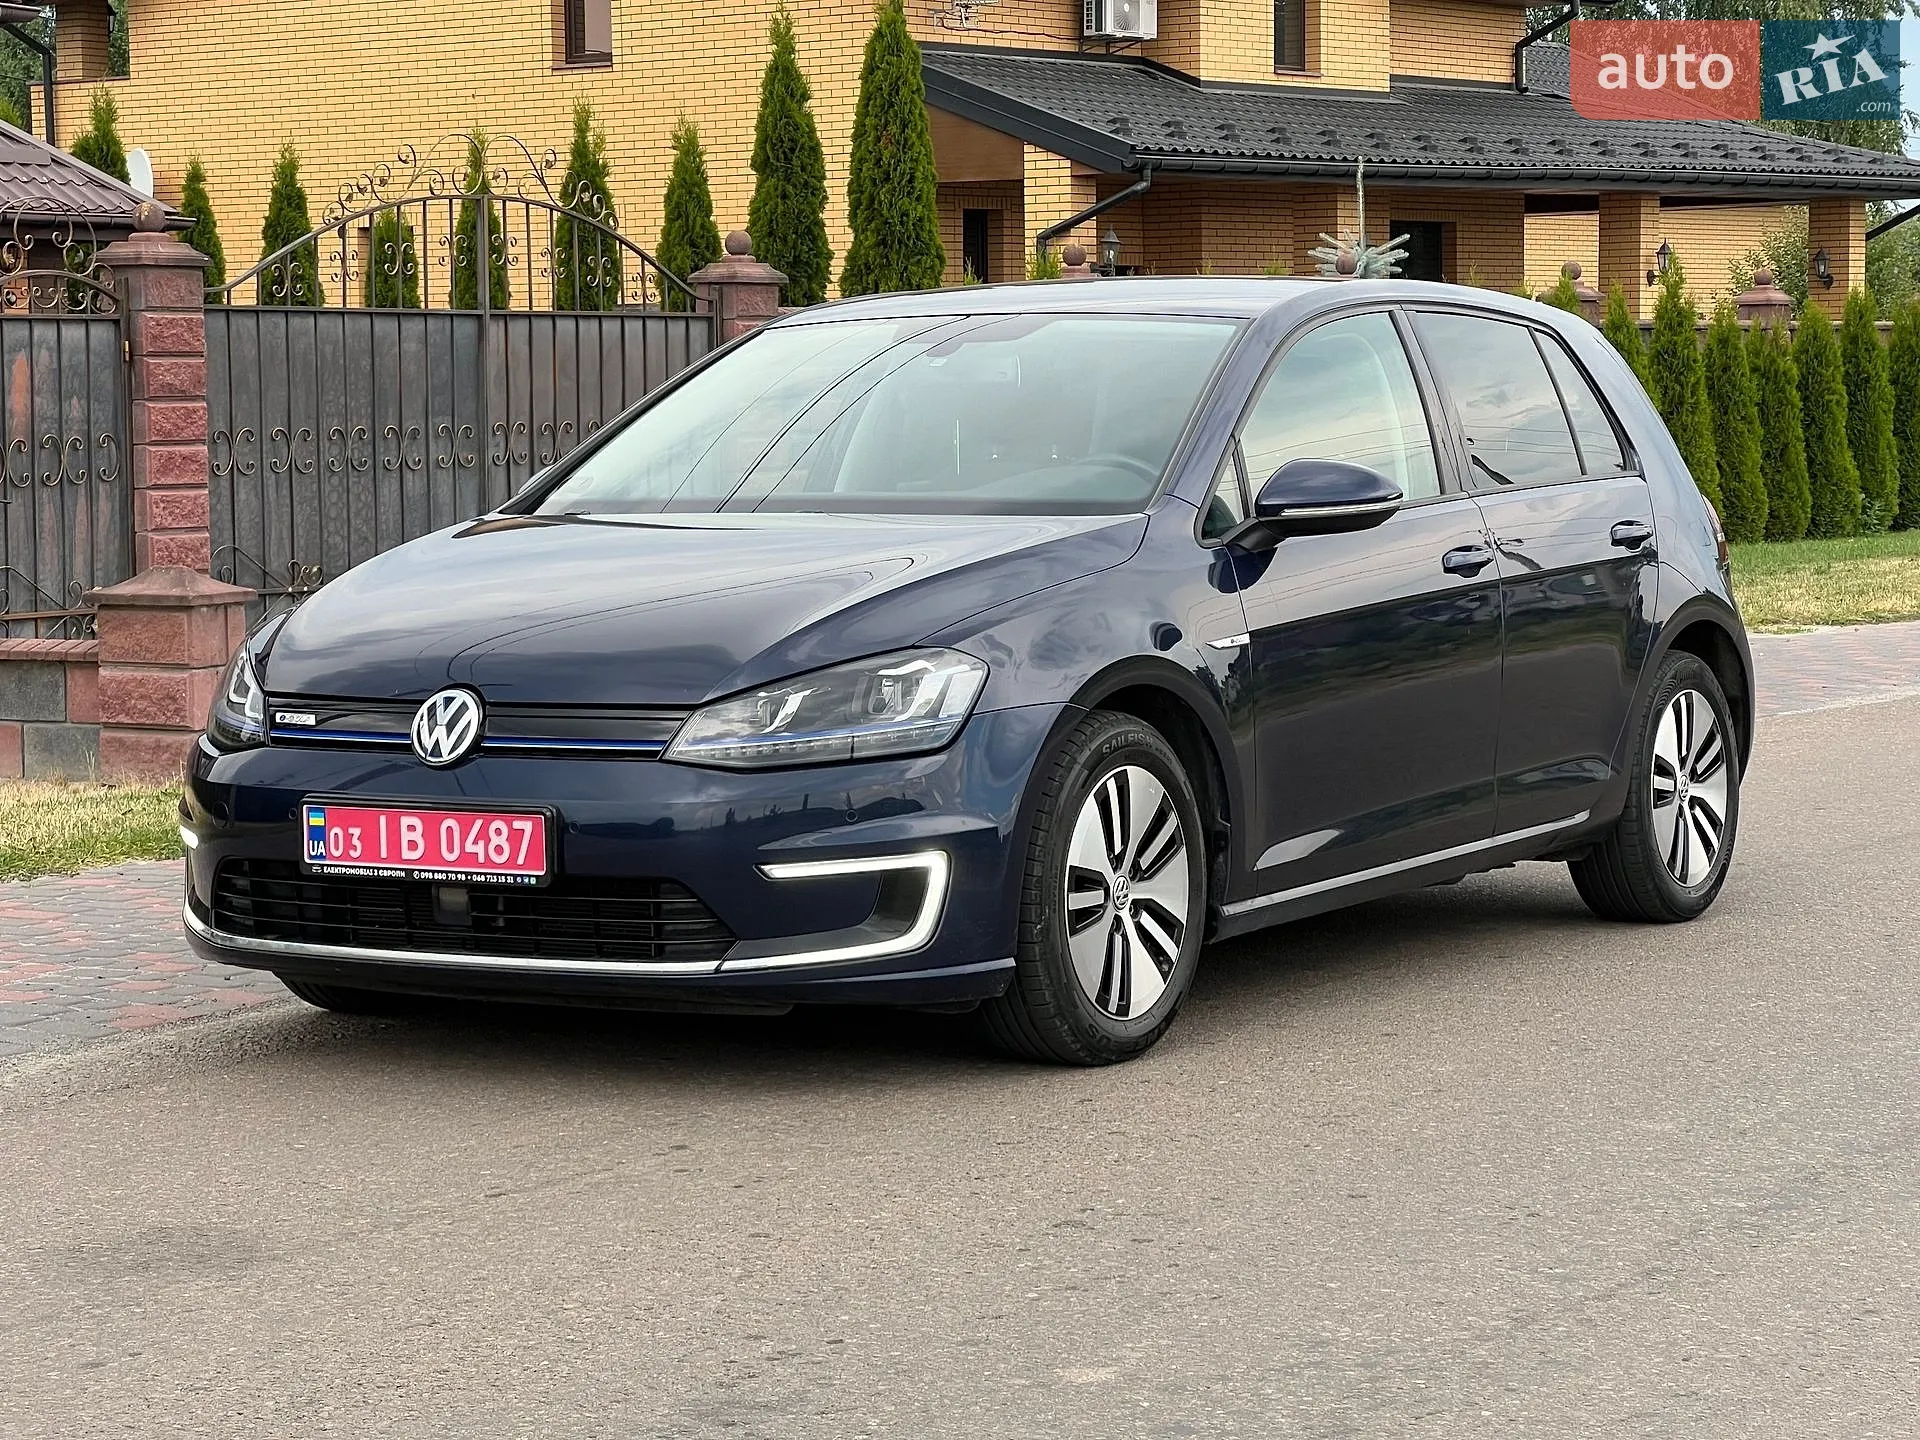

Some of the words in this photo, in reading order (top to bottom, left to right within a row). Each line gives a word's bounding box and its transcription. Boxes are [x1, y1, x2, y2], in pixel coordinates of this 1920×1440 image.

[309, 840, 326, 856] UA
[329, 826, 363, 859] 03
[439, 817, 534, 866] 0487
